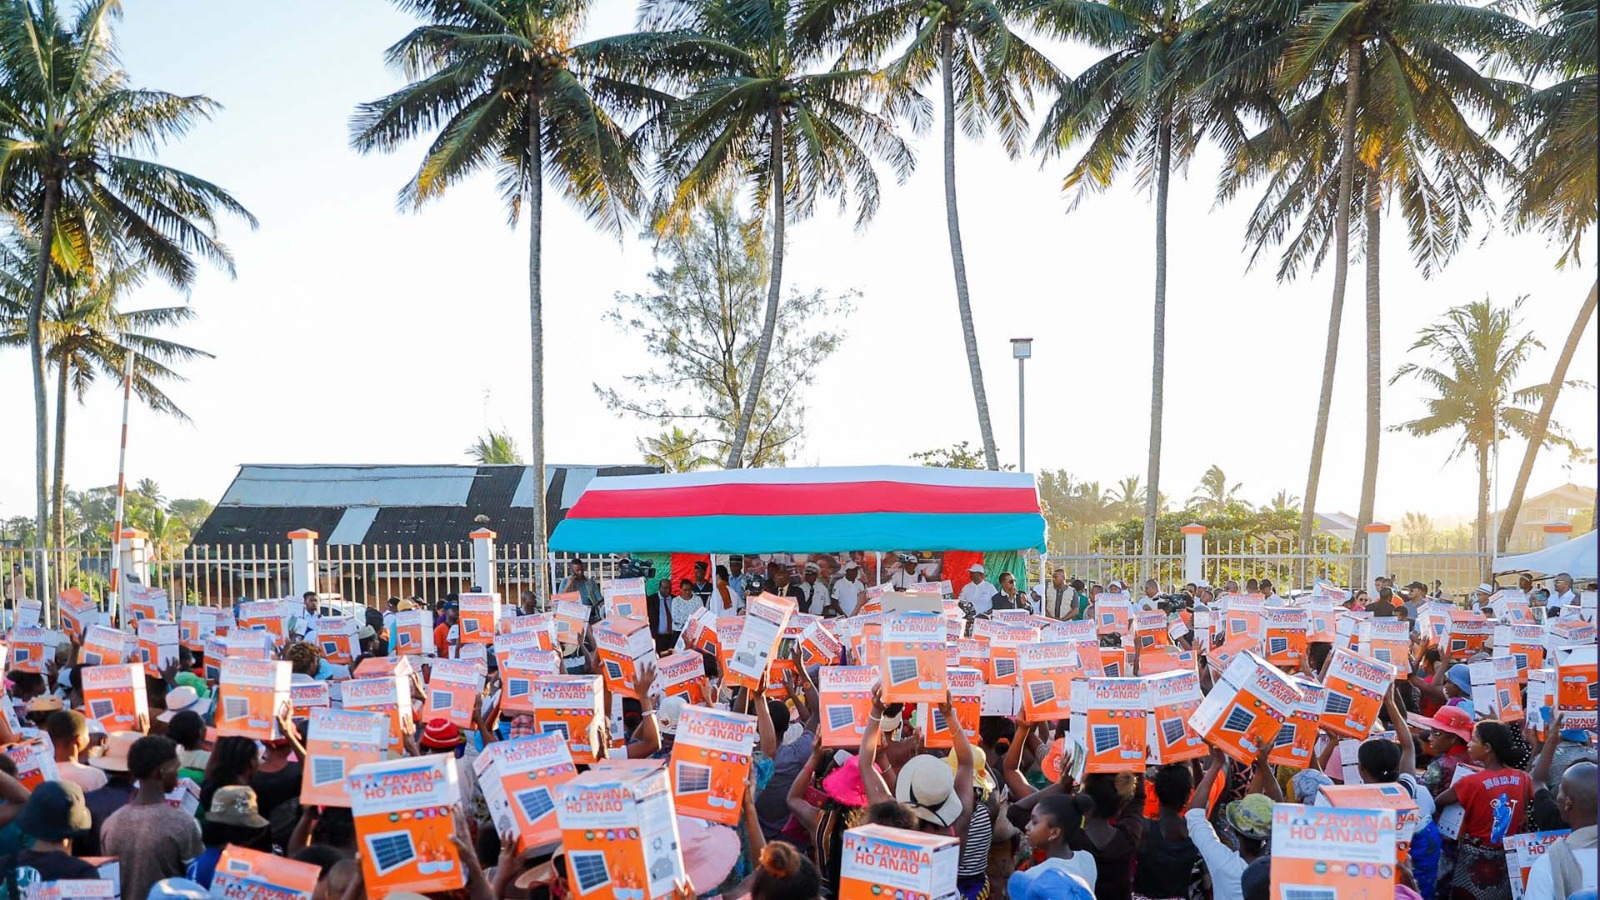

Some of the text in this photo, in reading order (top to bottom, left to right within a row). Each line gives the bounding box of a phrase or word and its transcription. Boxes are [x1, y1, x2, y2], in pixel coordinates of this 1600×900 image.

[892, 625, 906, 633] HO
[1044, 651, 1069, 659] ANAO
[668, 665, 698, 679] HO ANAO
[1341, 664, 1382, 684] HO ANAO
[1096, 691, 1140, 699] HO ANAO
[1159, 684, 1193, 696] HO ANAO
[1257, 678, 1292, 705] HO ANAO
[688, 723, 744, 742] HO ANAO
[506, 747, 558, 762] HO ANAO
[365, 782, 433, 799] HO ANAO
[566, 801, 622, 813] HO ANAO
[1290, 826, 1377, 844] HO ANAO
[1528, 845, 1545, 856] HO
[855, 853, 919, 875] HO ANAO
[225, 887, 246, 900] HO
